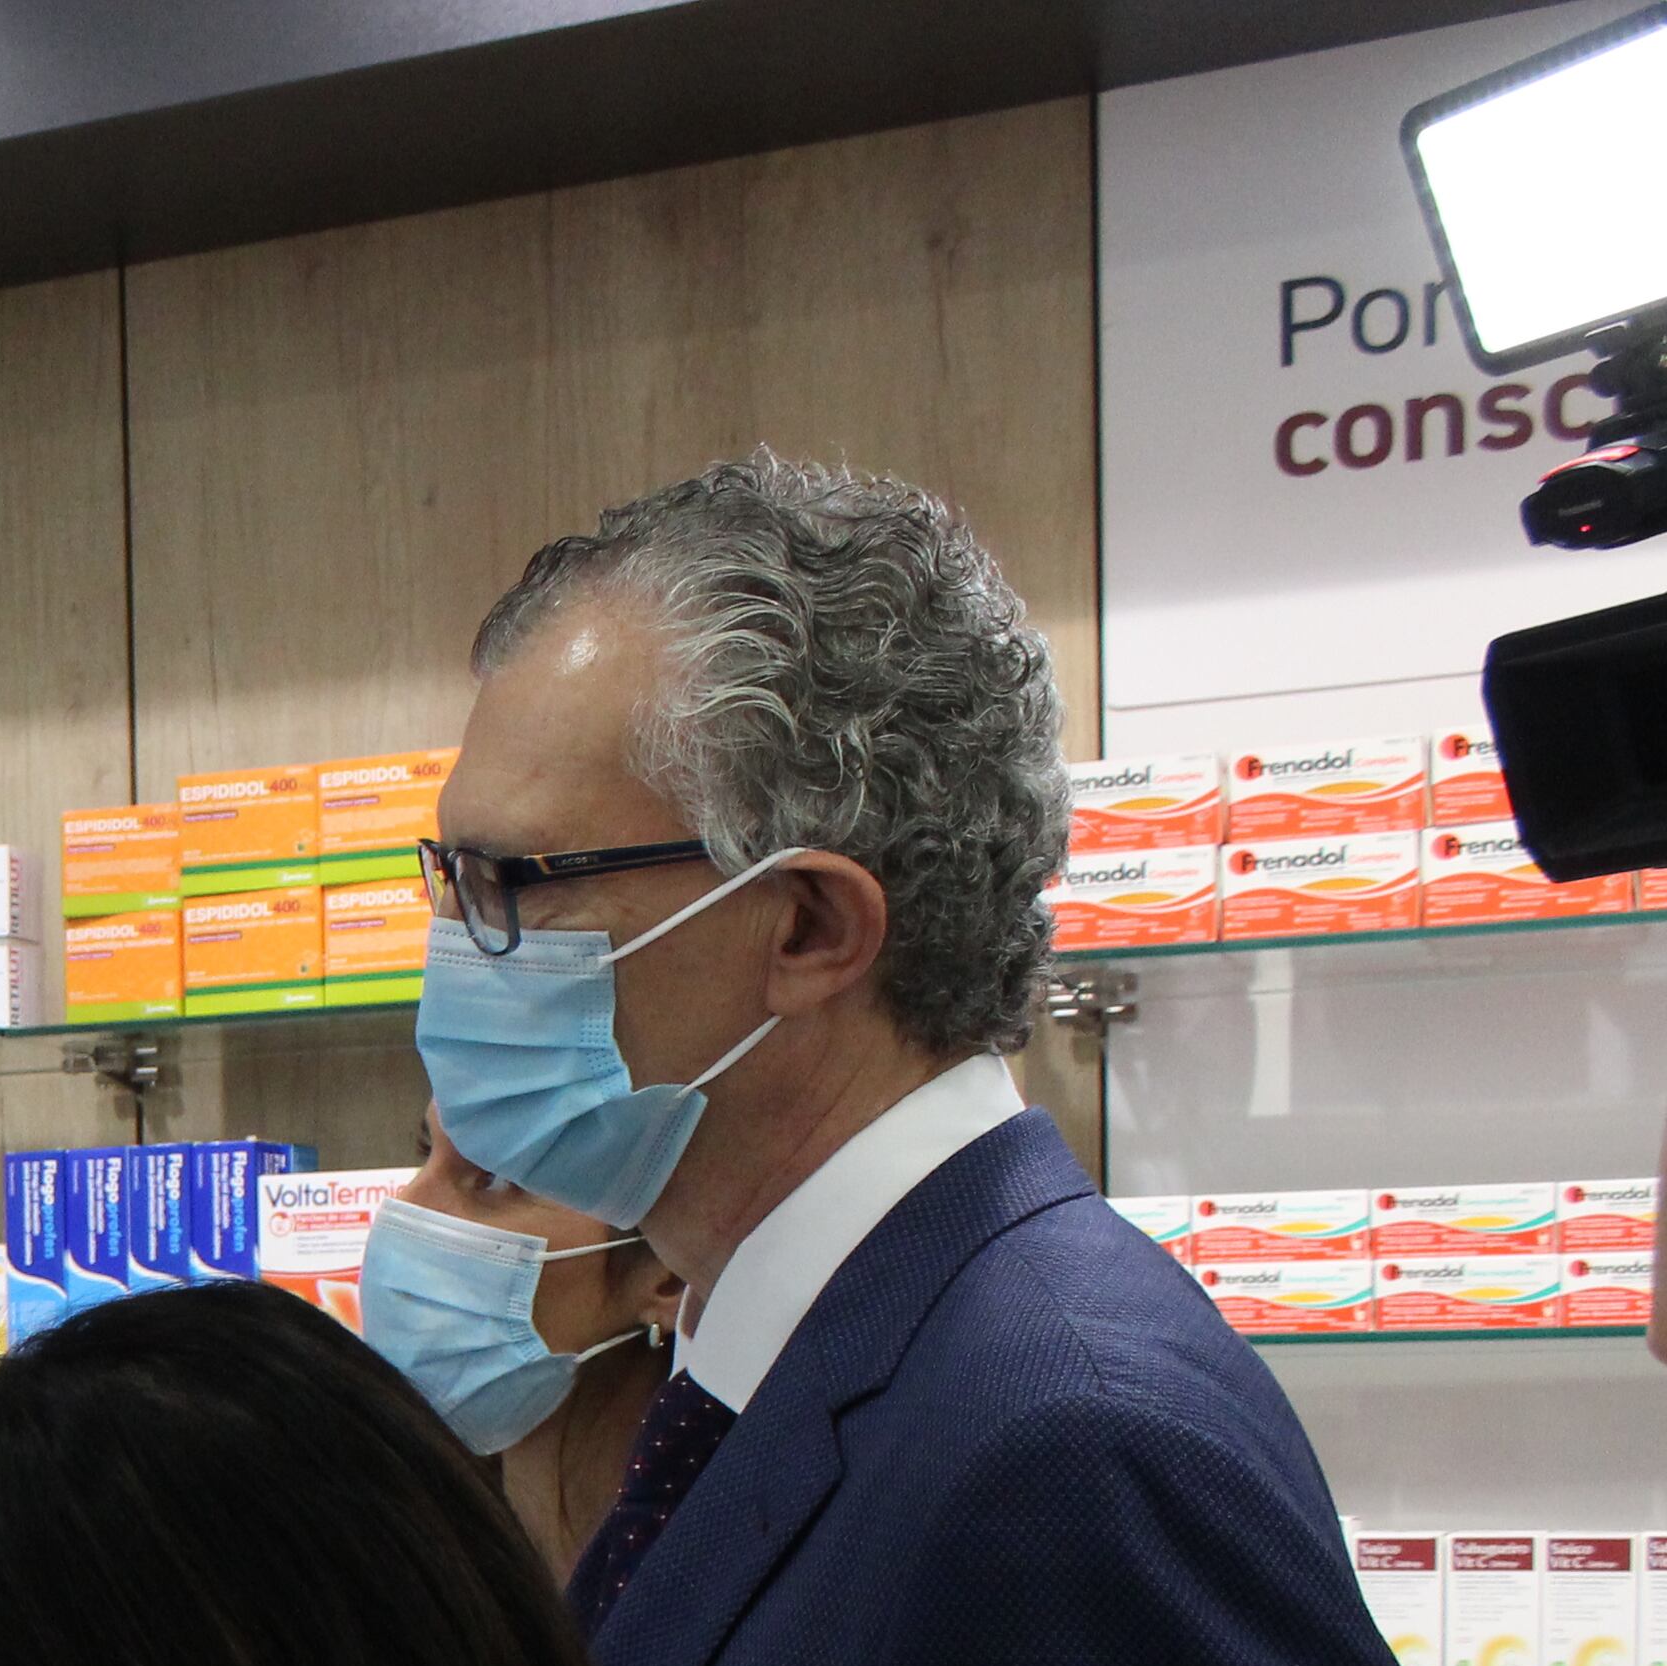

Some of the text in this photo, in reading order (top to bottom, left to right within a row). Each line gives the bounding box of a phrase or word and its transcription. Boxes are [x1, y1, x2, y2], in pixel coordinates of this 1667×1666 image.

[1275, 371, 1597, 478] consc
[320, 763, 442, 788] ESPIDIDOL 400
[1248, 748, 1355, 778] Frenadol
[179, 778, 297, 802] ESPIDIDOL 400
[1070, 766, 1152, 791] enadol
[1242, 846, 1349, 873] Frenadol
[1445, 837, 1523, 857] Frena
[1060, 861, 1148, 886] renadol
[186, 899, 301, 924] ESPIDIDOL 400
[327, 888, 419, 909] ESPIDIDOL
[41, 1159, 58, 1260] Flogoprofen
[105, 1157, 123, 1258] Flogoprofen
[167, 1153, 184, 1255] Flogoprofen
[230, 1151, 248, 1253] Flogoprofen
